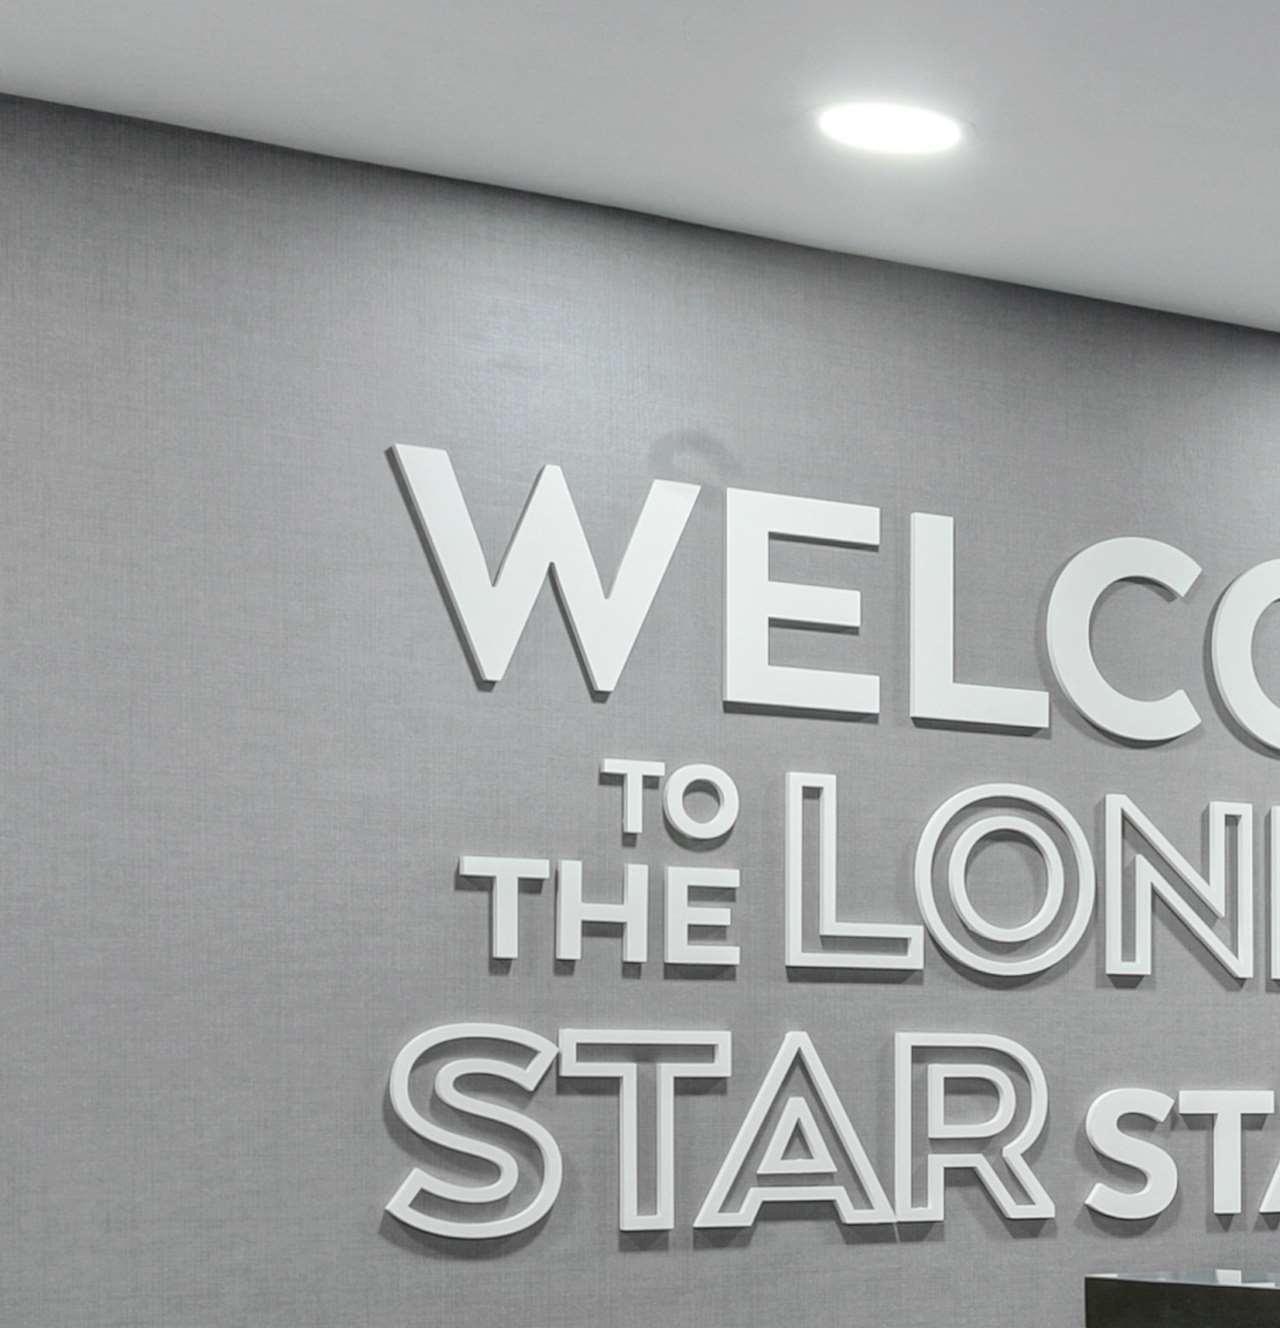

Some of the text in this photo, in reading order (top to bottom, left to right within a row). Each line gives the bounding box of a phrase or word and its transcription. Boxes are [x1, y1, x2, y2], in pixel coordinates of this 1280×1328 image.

[600, 758, 740, 842] TO
[457, 855, 740, 967] THE
[385, 1021, 1055, 1241] STAR
